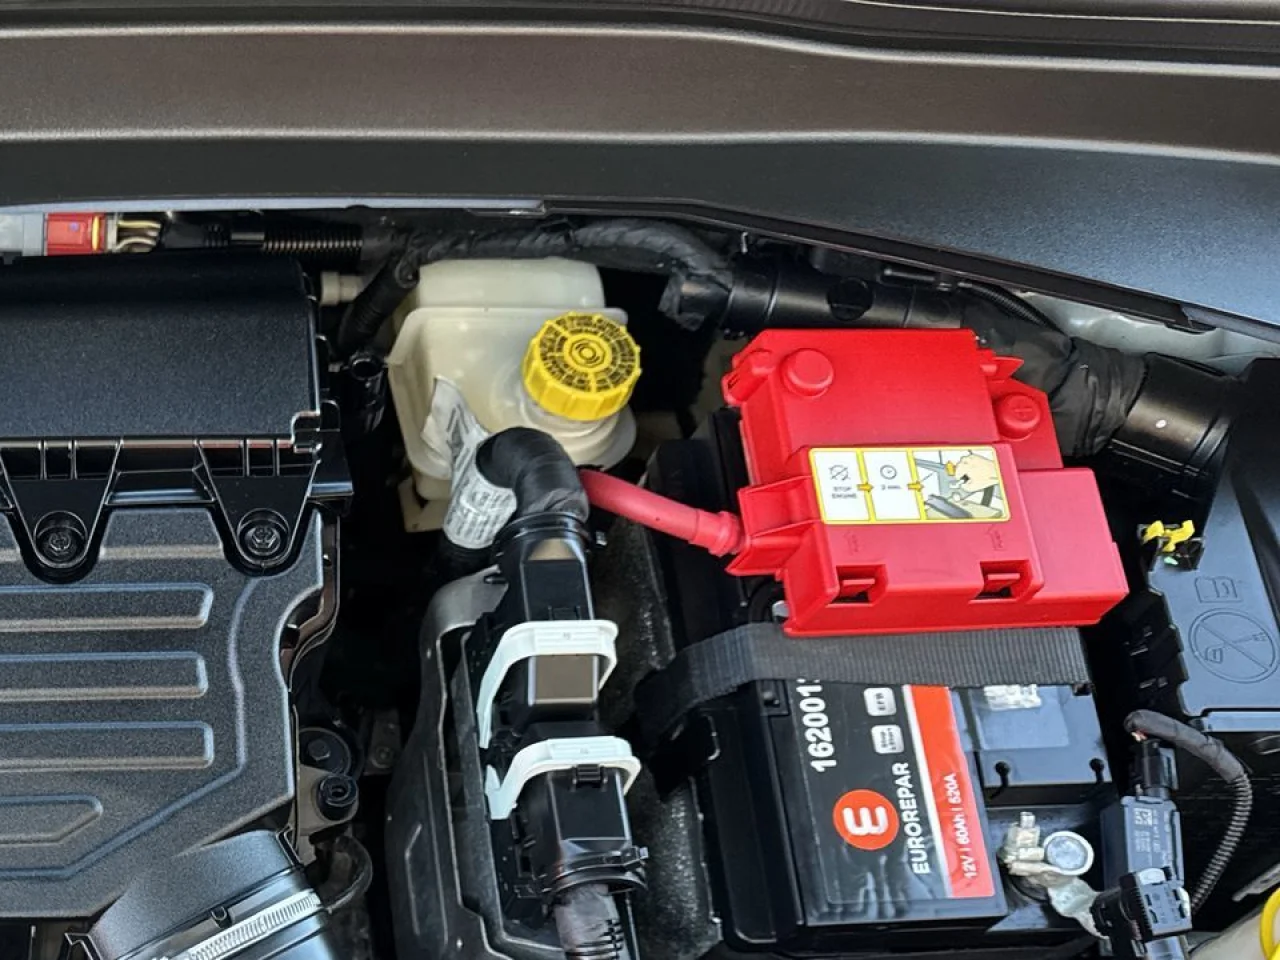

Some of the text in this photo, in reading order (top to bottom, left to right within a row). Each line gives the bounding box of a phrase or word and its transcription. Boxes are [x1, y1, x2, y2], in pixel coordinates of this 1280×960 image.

[796, 678, 837, 773] 162001
[841, 806, 889, 836] E
[891, 761, 932, 874] EUROREPAR
[952, 813, 970, 845] 60Ah
[960, 855, 978, 879] 12V
